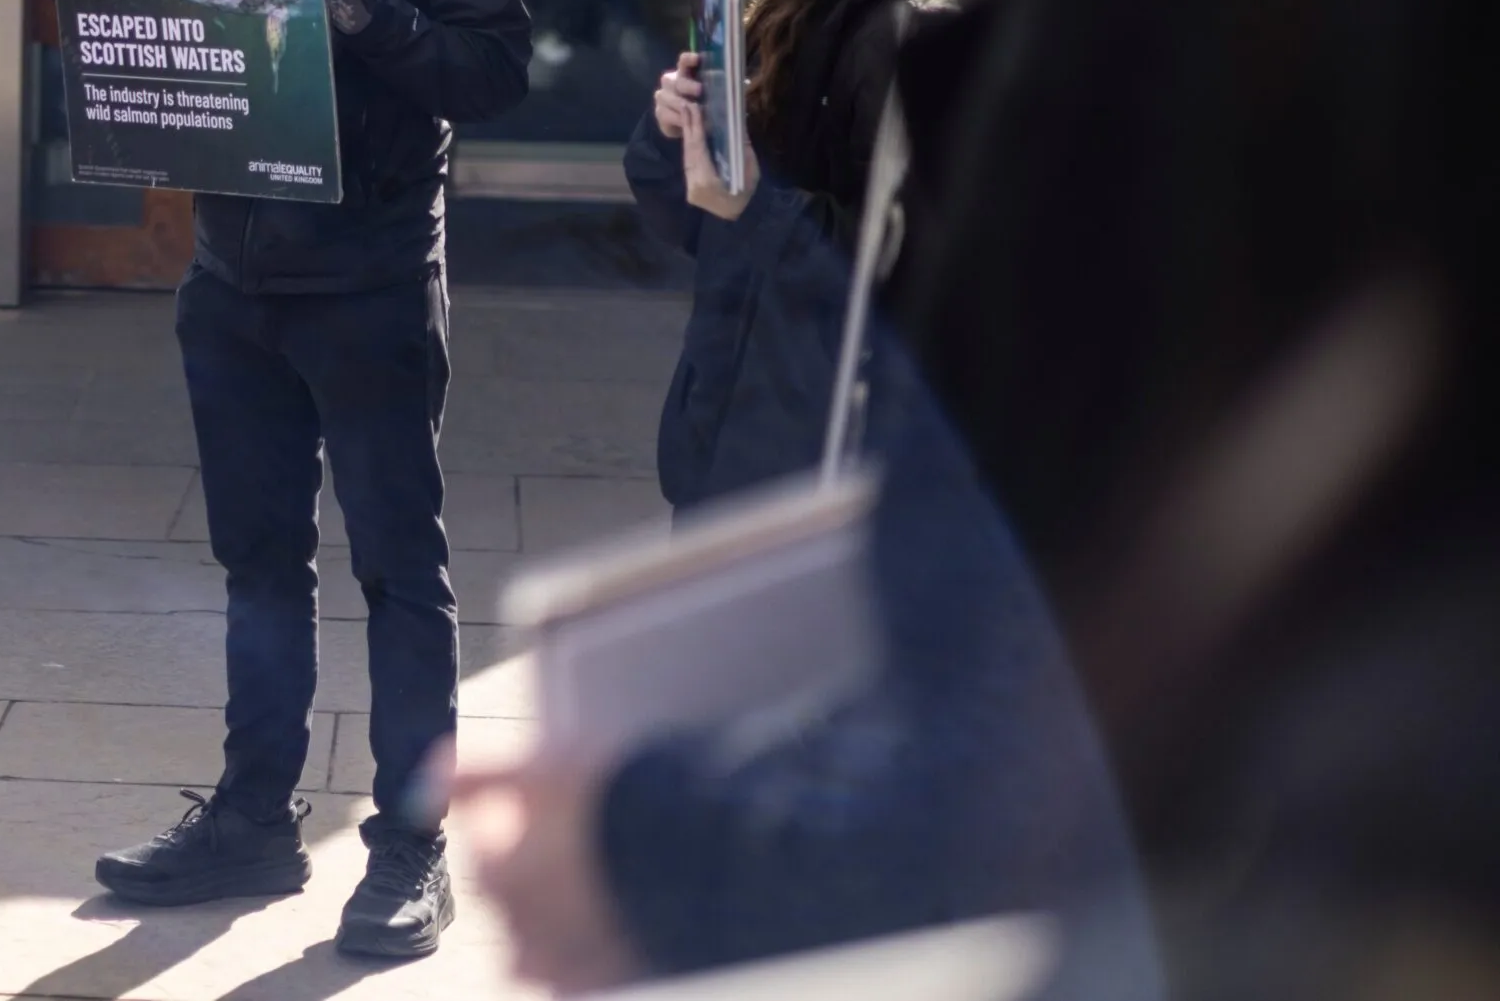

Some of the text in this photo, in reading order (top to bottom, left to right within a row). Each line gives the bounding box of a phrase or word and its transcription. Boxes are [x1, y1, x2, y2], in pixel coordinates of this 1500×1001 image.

[77, 13, 205, 43] ESCAPED INTO
[79, 40, 246, 74] SCOTTISH WATERS
[83, 83, 250, 116] The industry is threatening
[85, 103, 234, 130] wild salmon populations
[248, 159, 322, 177] animalEQUALITY
[270, 174, 323, 184] UNITED KINGDOM
